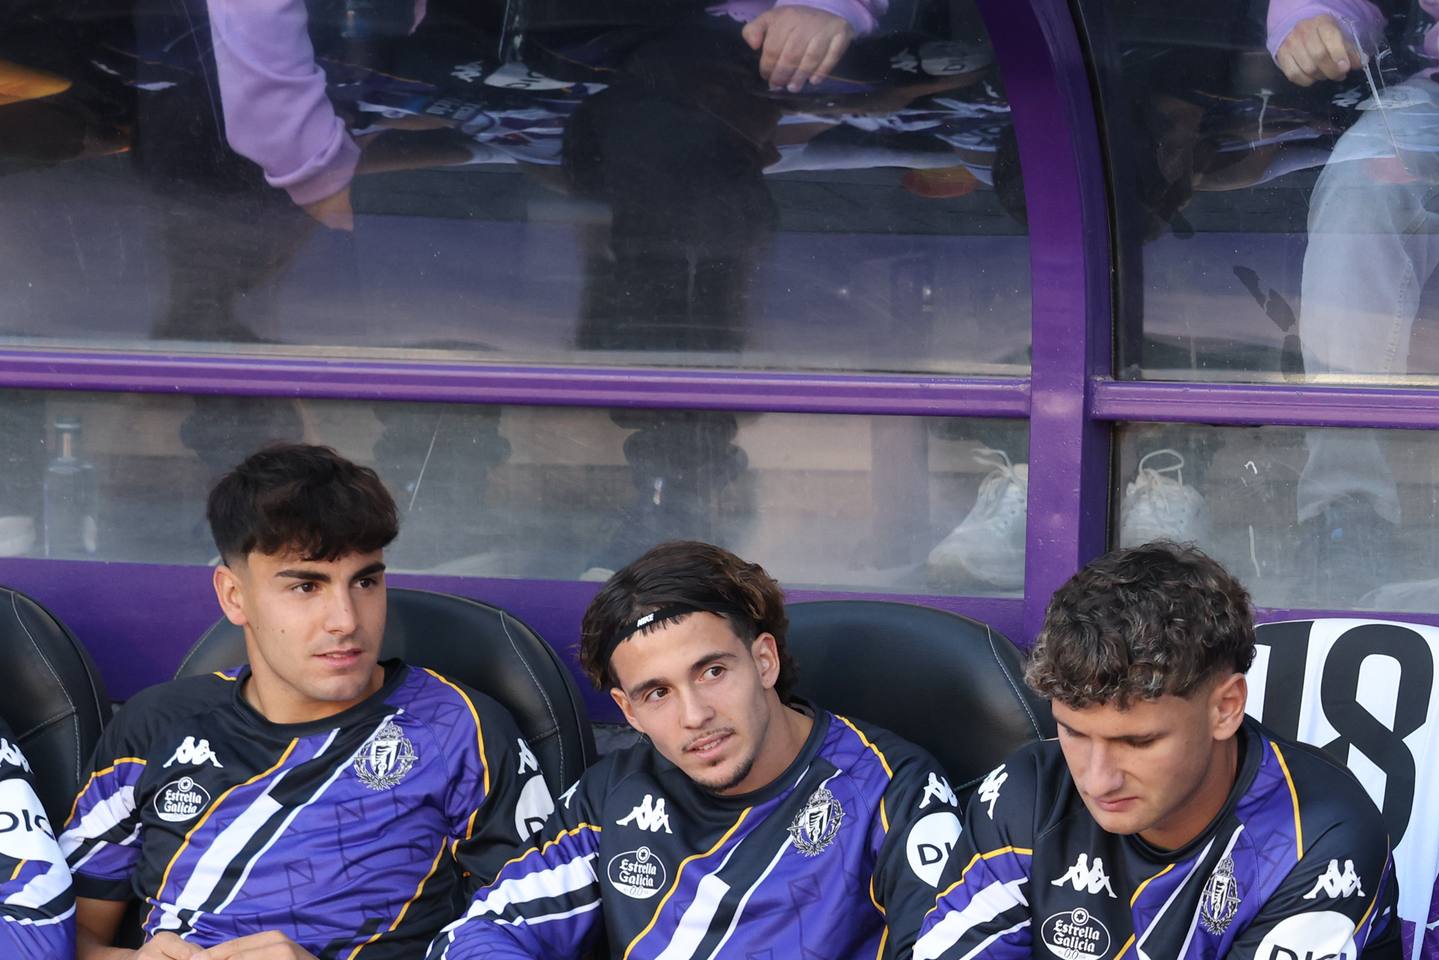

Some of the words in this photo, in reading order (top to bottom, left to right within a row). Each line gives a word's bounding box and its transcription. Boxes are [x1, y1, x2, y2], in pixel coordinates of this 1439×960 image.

[1254, 620, 1434, 850] 18
[165, 789, 202, 804] Estrella
[164, 799, 198, 814] Galicia
[619, 858, 657, 875] Estrella
[619, 870, 654, 887] Galicia
[1053, 919, 1100, 941] Estrella
[1053, 932, 1095, 953] Galicia
